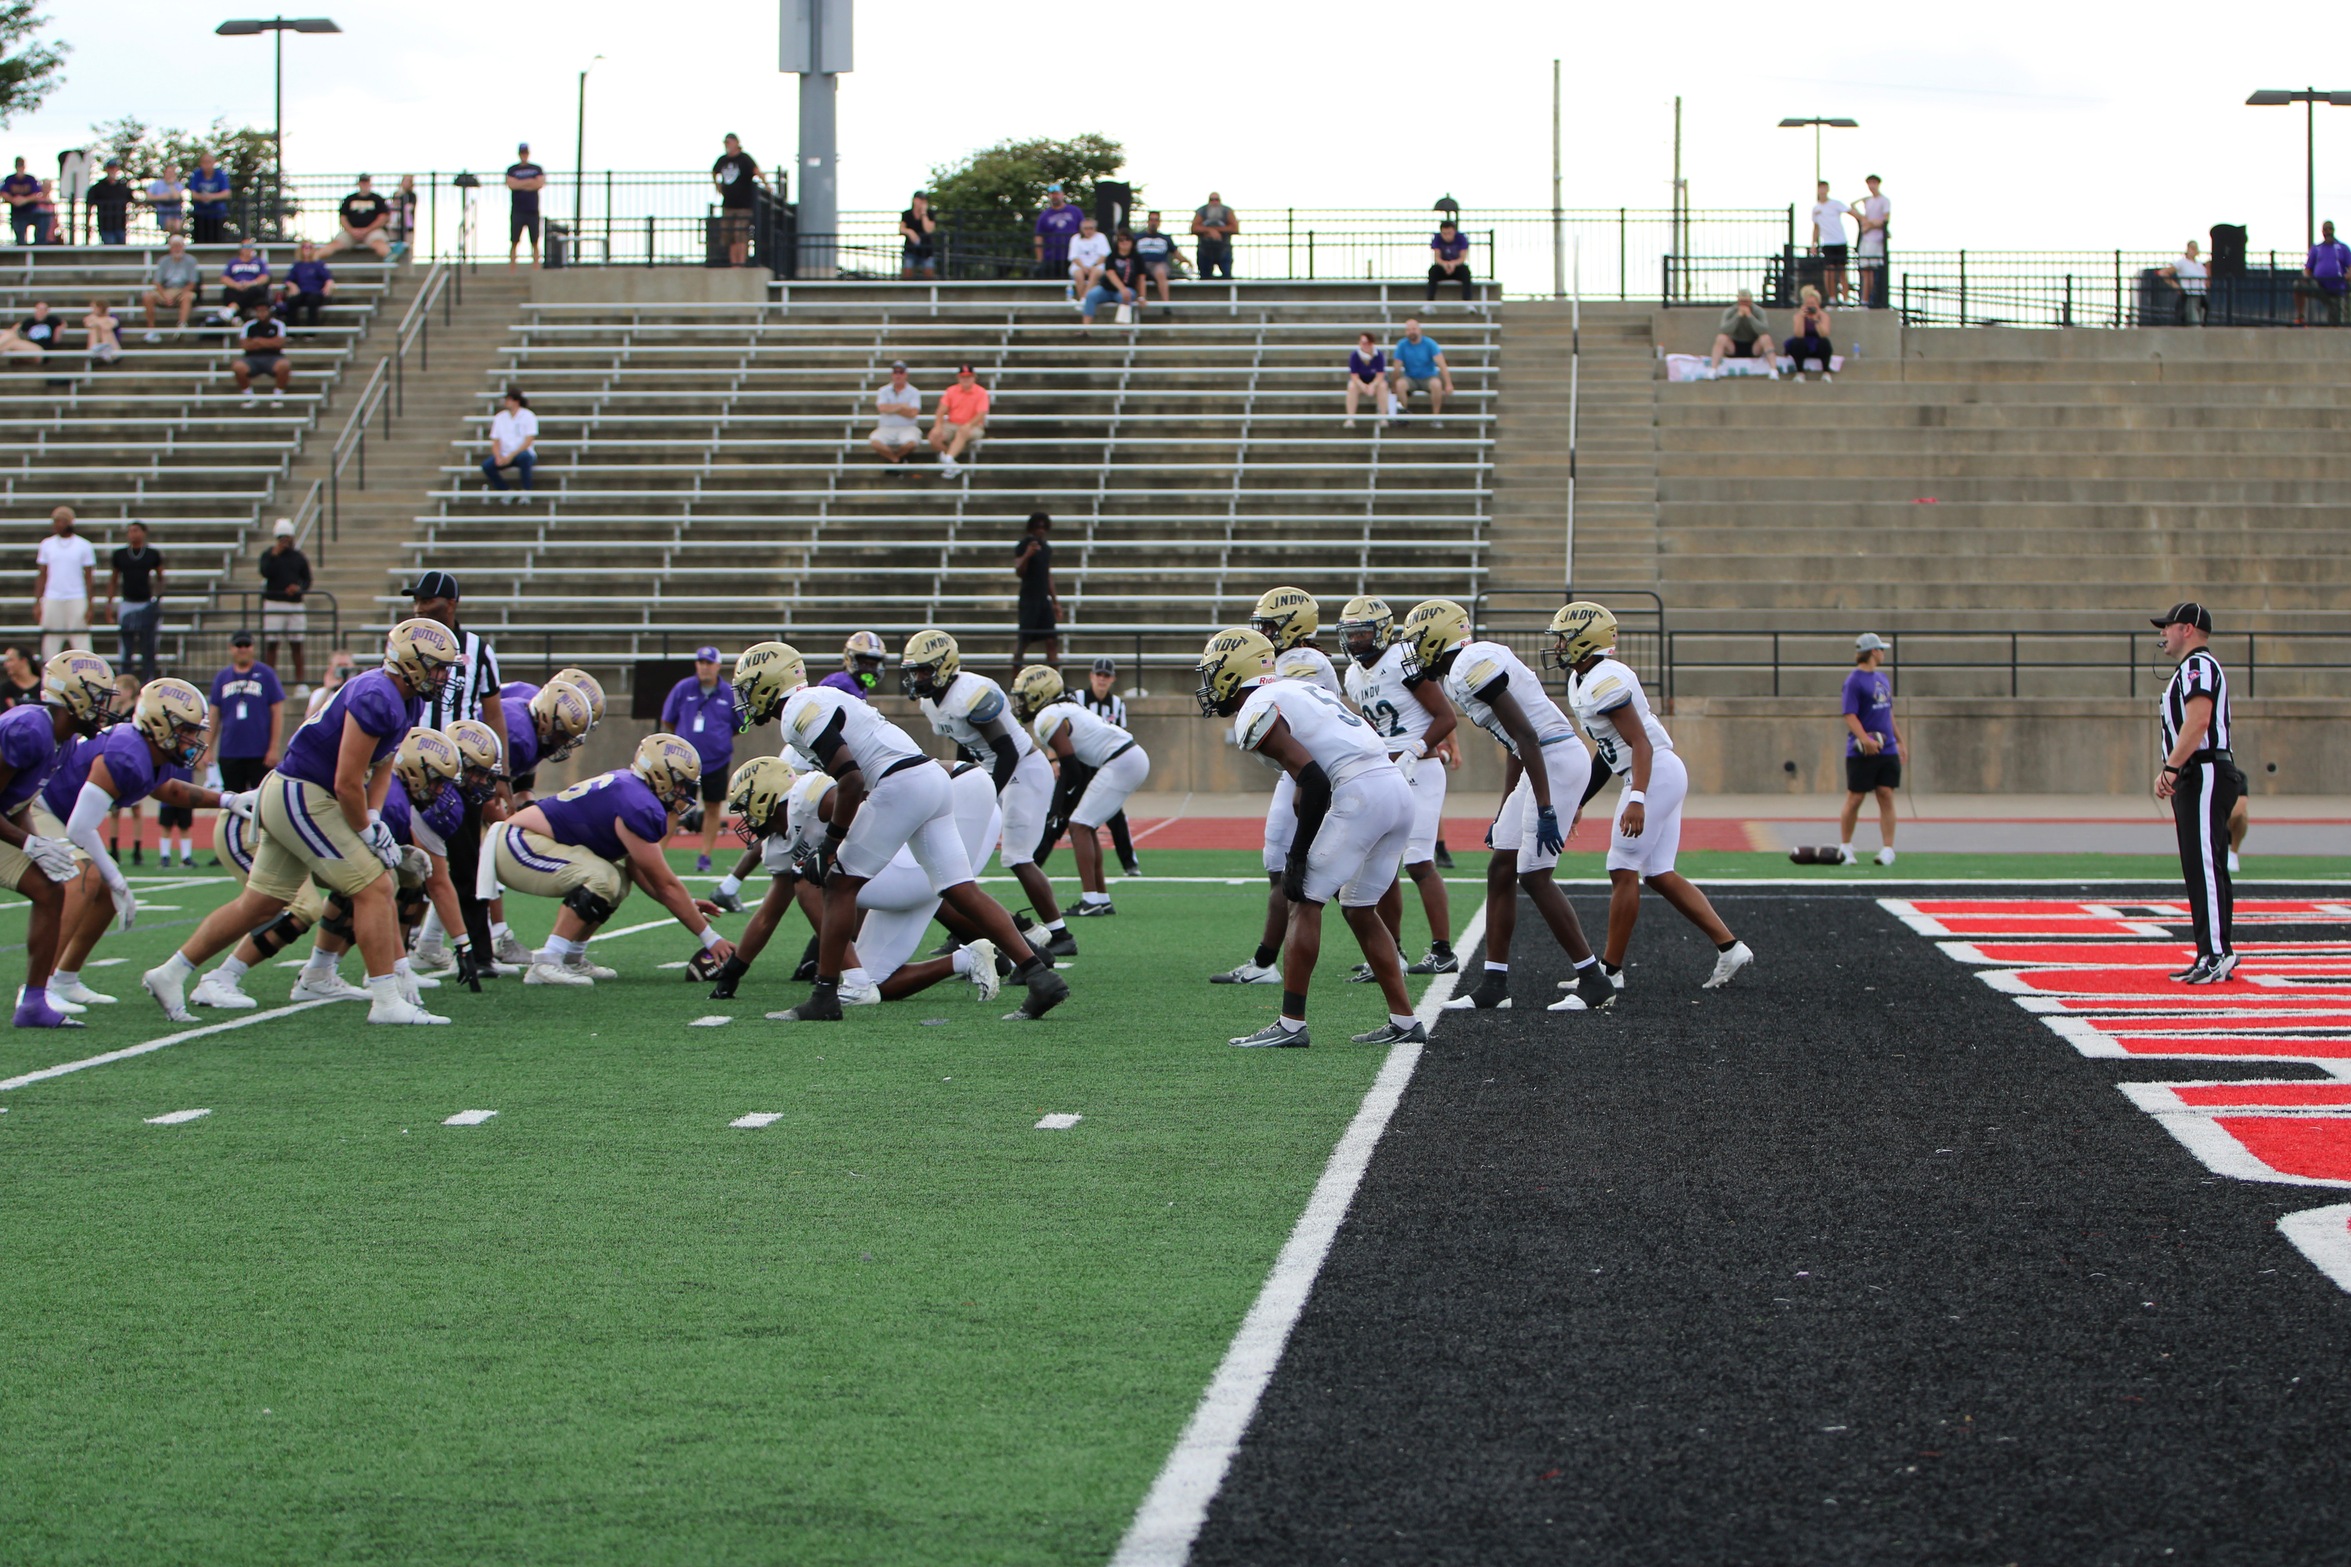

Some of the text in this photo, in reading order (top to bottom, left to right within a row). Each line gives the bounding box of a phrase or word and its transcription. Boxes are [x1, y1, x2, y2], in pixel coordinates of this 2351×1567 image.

[1274, 595, 1305, 608] INDY
[1408, 608, 1438, 628] INDY
[1565, 609, 1597, 622] INDY
[410, 626, 446, 650] BUTLER
[1208, 639, 1242, 655] INDY
[72, 659, 106, 677] BUTLER
[739, 651, 771, 673] INDY
[158, 685, 192, 709] BUTLER
[1360, 685, 1380, 701] INDY
[416, 737, 449, 762] BUTLER
[457, 728, 488, 753] BUTLER
[663, 743, 693, 766] BUTLER
[733, 764, 759, 789] INDY
